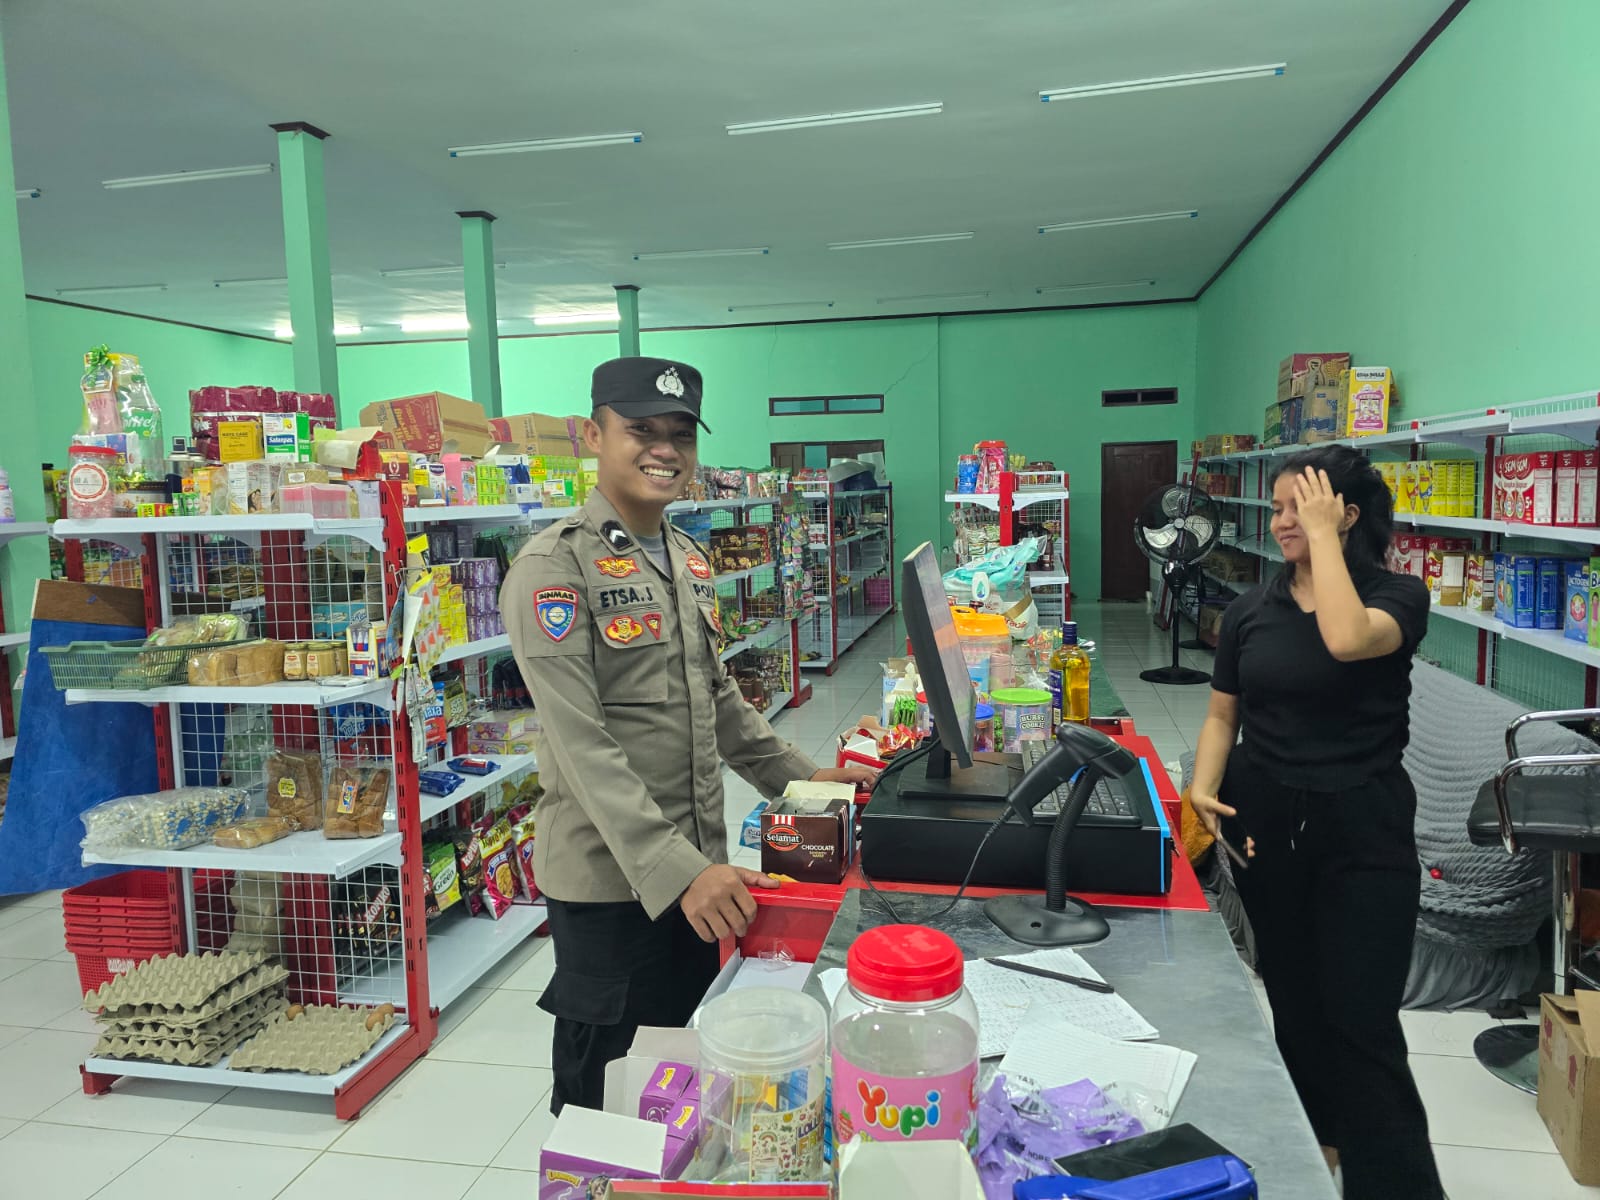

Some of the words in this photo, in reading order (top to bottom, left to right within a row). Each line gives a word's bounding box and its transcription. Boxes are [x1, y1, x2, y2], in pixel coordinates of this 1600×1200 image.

[1516, 457, 1528, 473] SGM
[538, 591, 575, 601] BINMAS
[766, 833, 801, 844] Selamat
[434, 869, 455, 892] Green
[857, 1078, 941, 1138] Yupi
